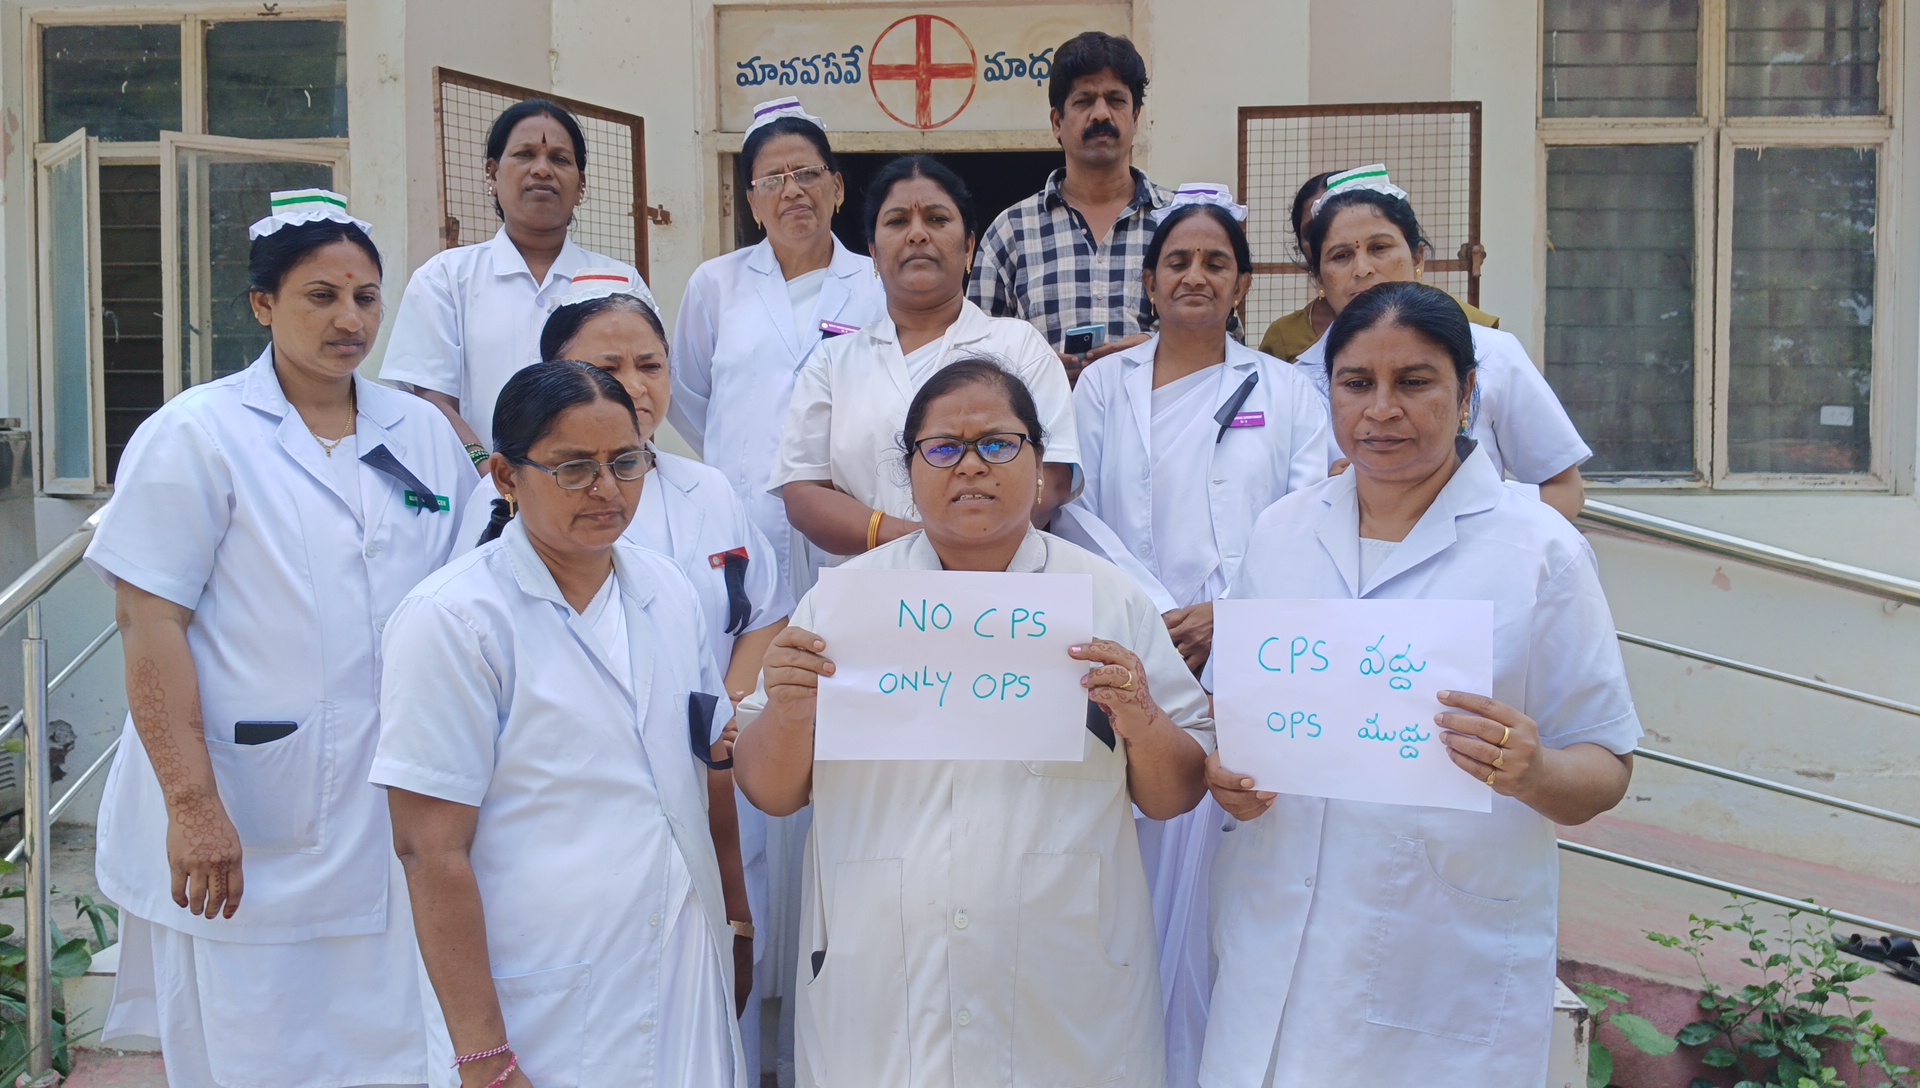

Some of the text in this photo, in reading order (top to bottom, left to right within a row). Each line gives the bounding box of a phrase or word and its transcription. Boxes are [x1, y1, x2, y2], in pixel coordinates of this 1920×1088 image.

[736, 44, 1054, 87] మానవసేవే మాధ
[898, 598, 1048, 640] NO CPS
[1257, 634, 1428, 692] CPS వద్దు
[878, 665, 1032, 708] ONLY OPS
[1266, 710, 1432, 760] OPS ముద్దు
